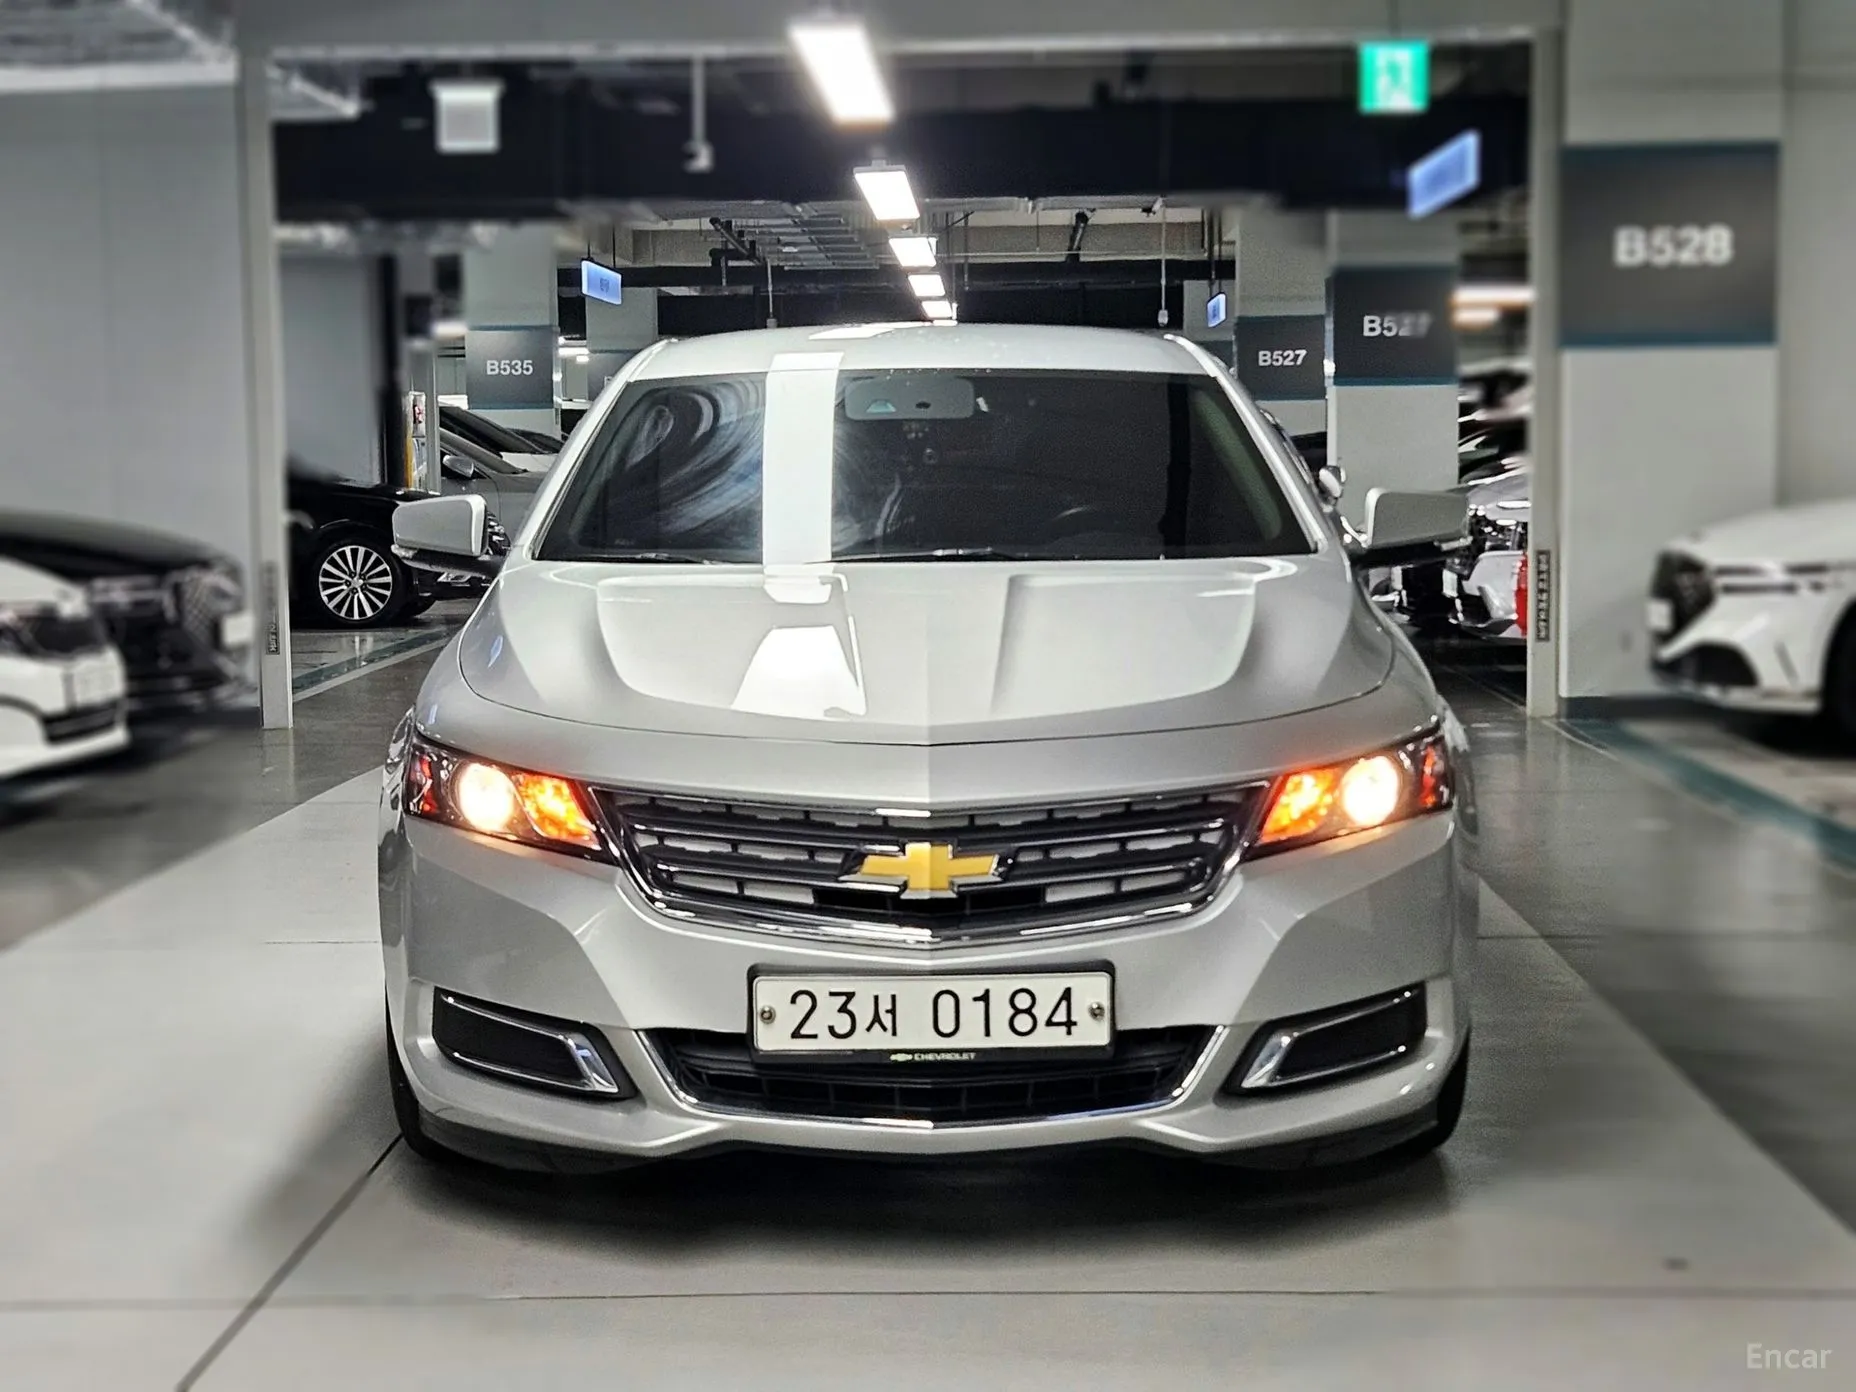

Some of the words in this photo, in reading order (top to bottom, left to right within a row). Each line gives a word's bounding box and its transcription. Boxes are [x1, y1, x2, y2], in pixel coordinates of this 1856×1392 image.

[1613, 222, 1735, 269] B528
[486, 359, 534, 376] B535
[1258, 349, 1307, 367] B527
[789, 988, 897, 1040] 23서
[931, 986, 1078, 1038] 0184
